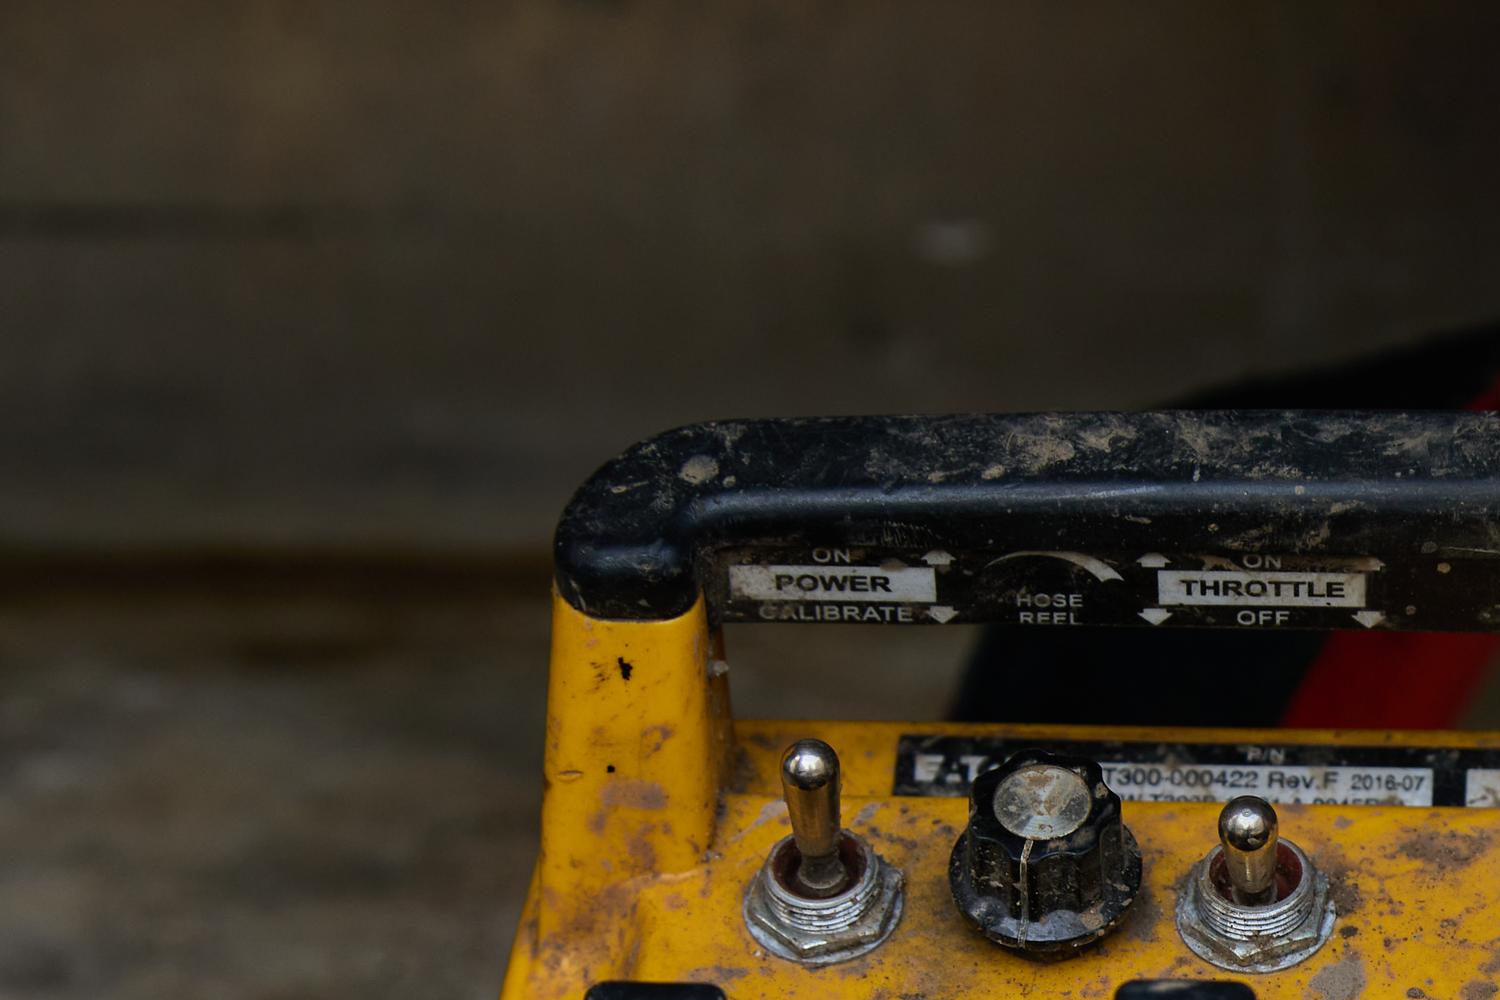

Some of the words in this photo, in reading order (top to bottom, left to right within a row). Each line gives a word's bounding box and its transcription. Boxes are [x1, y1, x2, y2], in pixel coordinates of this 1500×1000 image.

[812, 547, 851, 564] ON
[1242, 553, 1283, 570] ON
[774, 574, 893, 592] POWER
[1179, 579, 1346, 599] THROTTLE
[1016, 592, 1084, 608] HOSE
[758, 604, 914, 622] CALIBRATE
[1018, 611, 1083, 625] REEL
[1236, 609, 1291, 626] OFF
